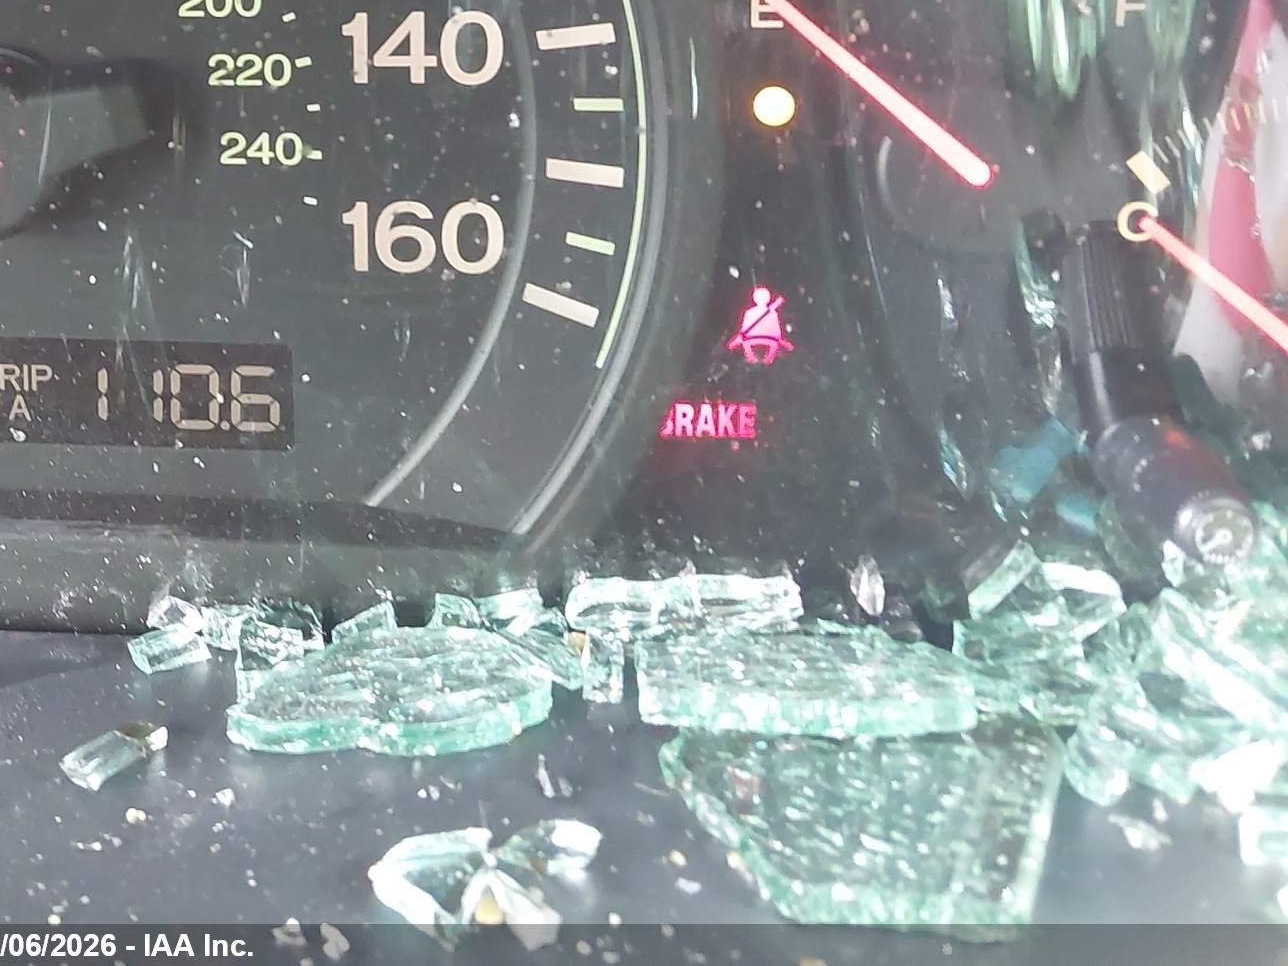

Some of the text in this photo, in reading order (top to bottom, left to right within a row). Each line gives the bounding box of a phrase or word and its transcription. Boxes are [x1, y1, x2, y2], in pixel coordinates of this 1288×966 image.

[342, 10, 505, 86] 140
[208, 54, 291, 87] 220
[220, 132, 303, 165] 240
[342, 201, 505, 274] 160
[1117, 201, 1159, 242] C
[9, 396, 32, 423] A
